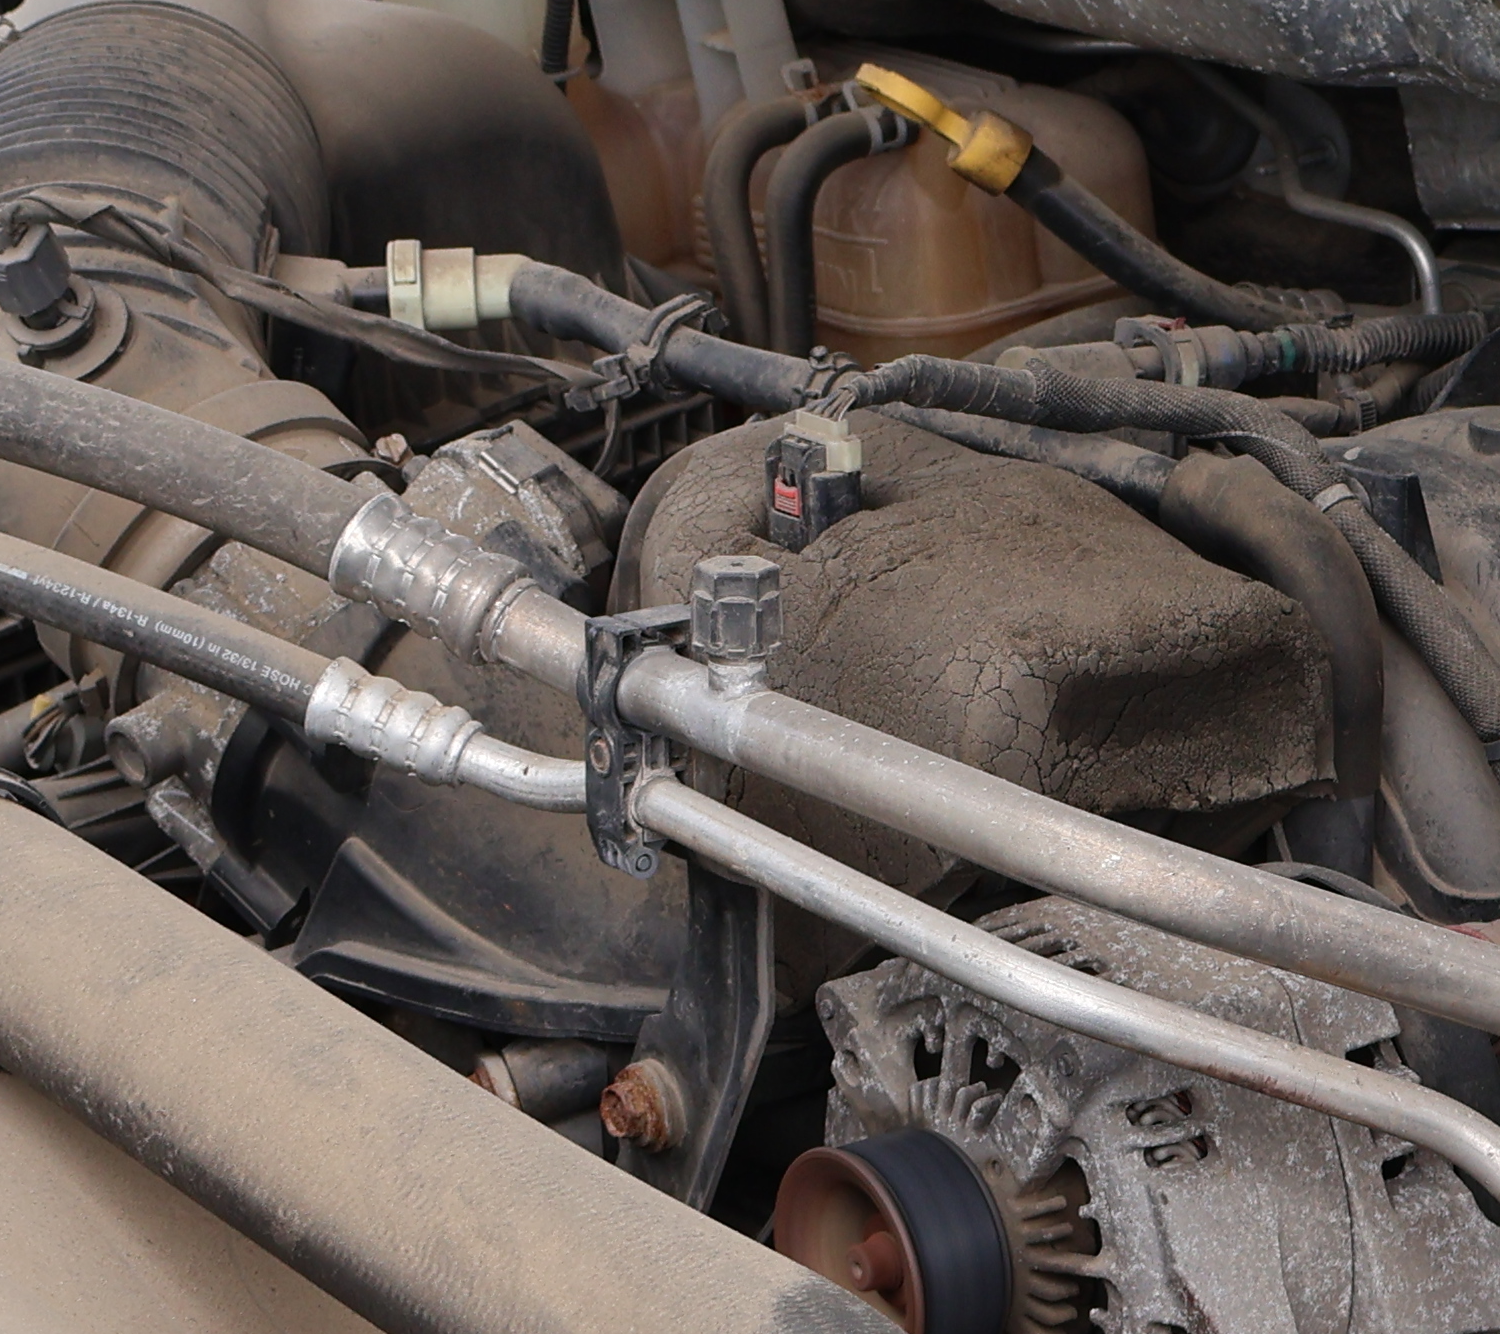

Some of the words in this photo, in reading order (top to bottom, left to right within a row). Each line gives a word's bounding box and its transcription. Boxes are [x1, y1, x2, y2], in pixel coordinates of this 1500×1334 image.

[31, 570, 92, 607] R-1234yf
[100, 597, 149, 628] R-134a
[153, 616, 206, 650] (10mm)
[206, 641, 221, 656] in
[220, 647, 258, 672] 13/32
[259, 663, 301, 691] HOSE
